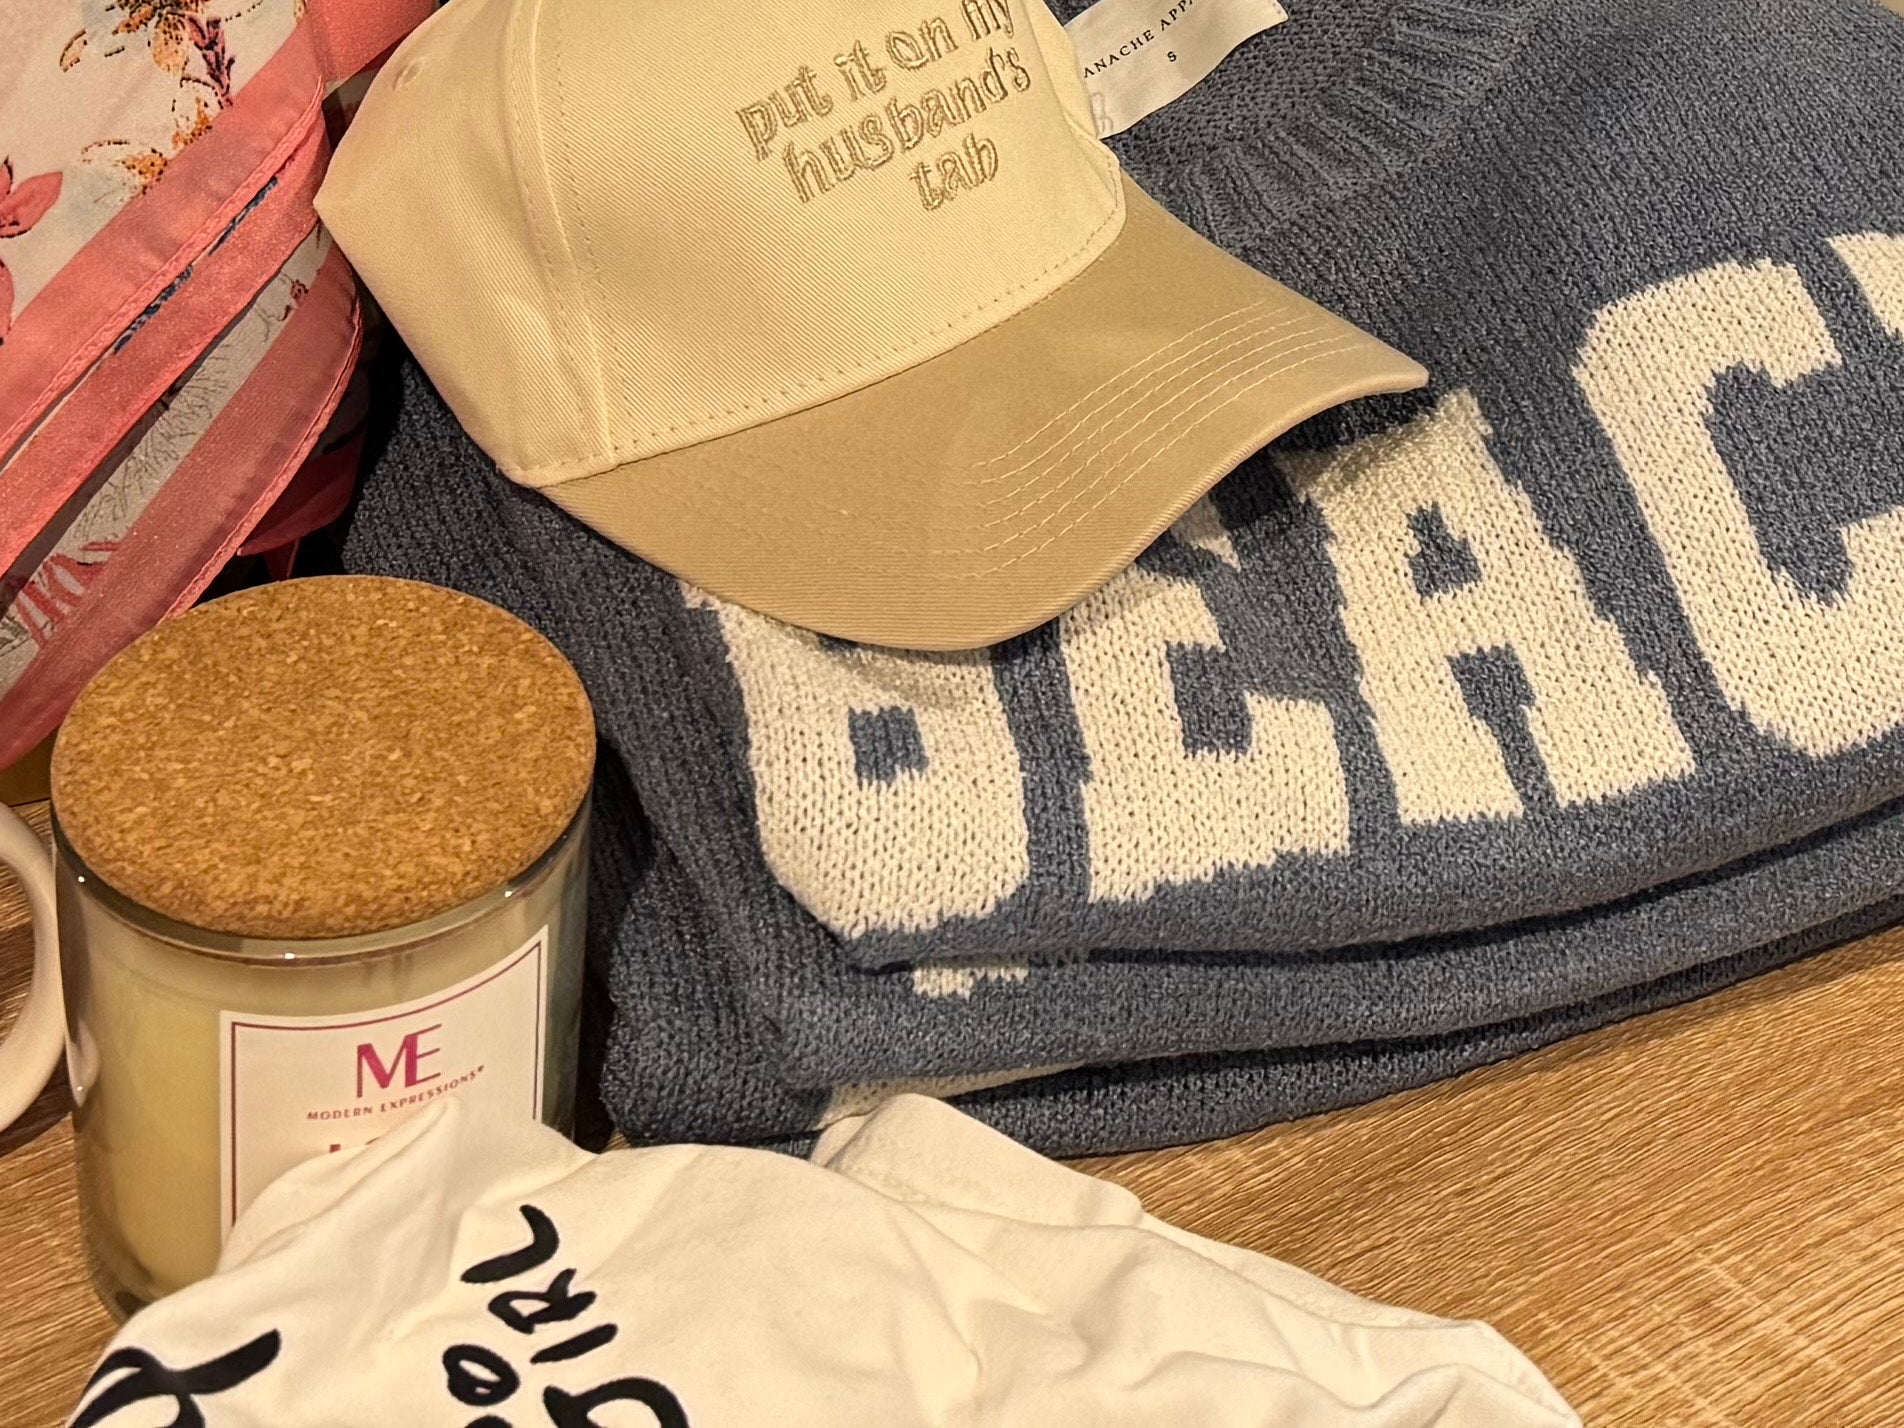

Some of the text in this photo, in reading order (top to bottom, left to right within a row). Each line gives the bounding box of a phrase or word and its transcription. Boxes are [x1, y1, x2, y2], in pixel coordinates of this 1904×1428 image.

[736, 65, 835, 162] put
[833, 39, 888, 102] it
[885, 16, 959, 72] on
[1167, 51, 1177, 63] S
[783, 45, 1032, 204] husband's
[909, 132, 999, 212] tab
[356, 1022, 443, 1099] ME
[306, 1104, 374, 1121] MODERN
